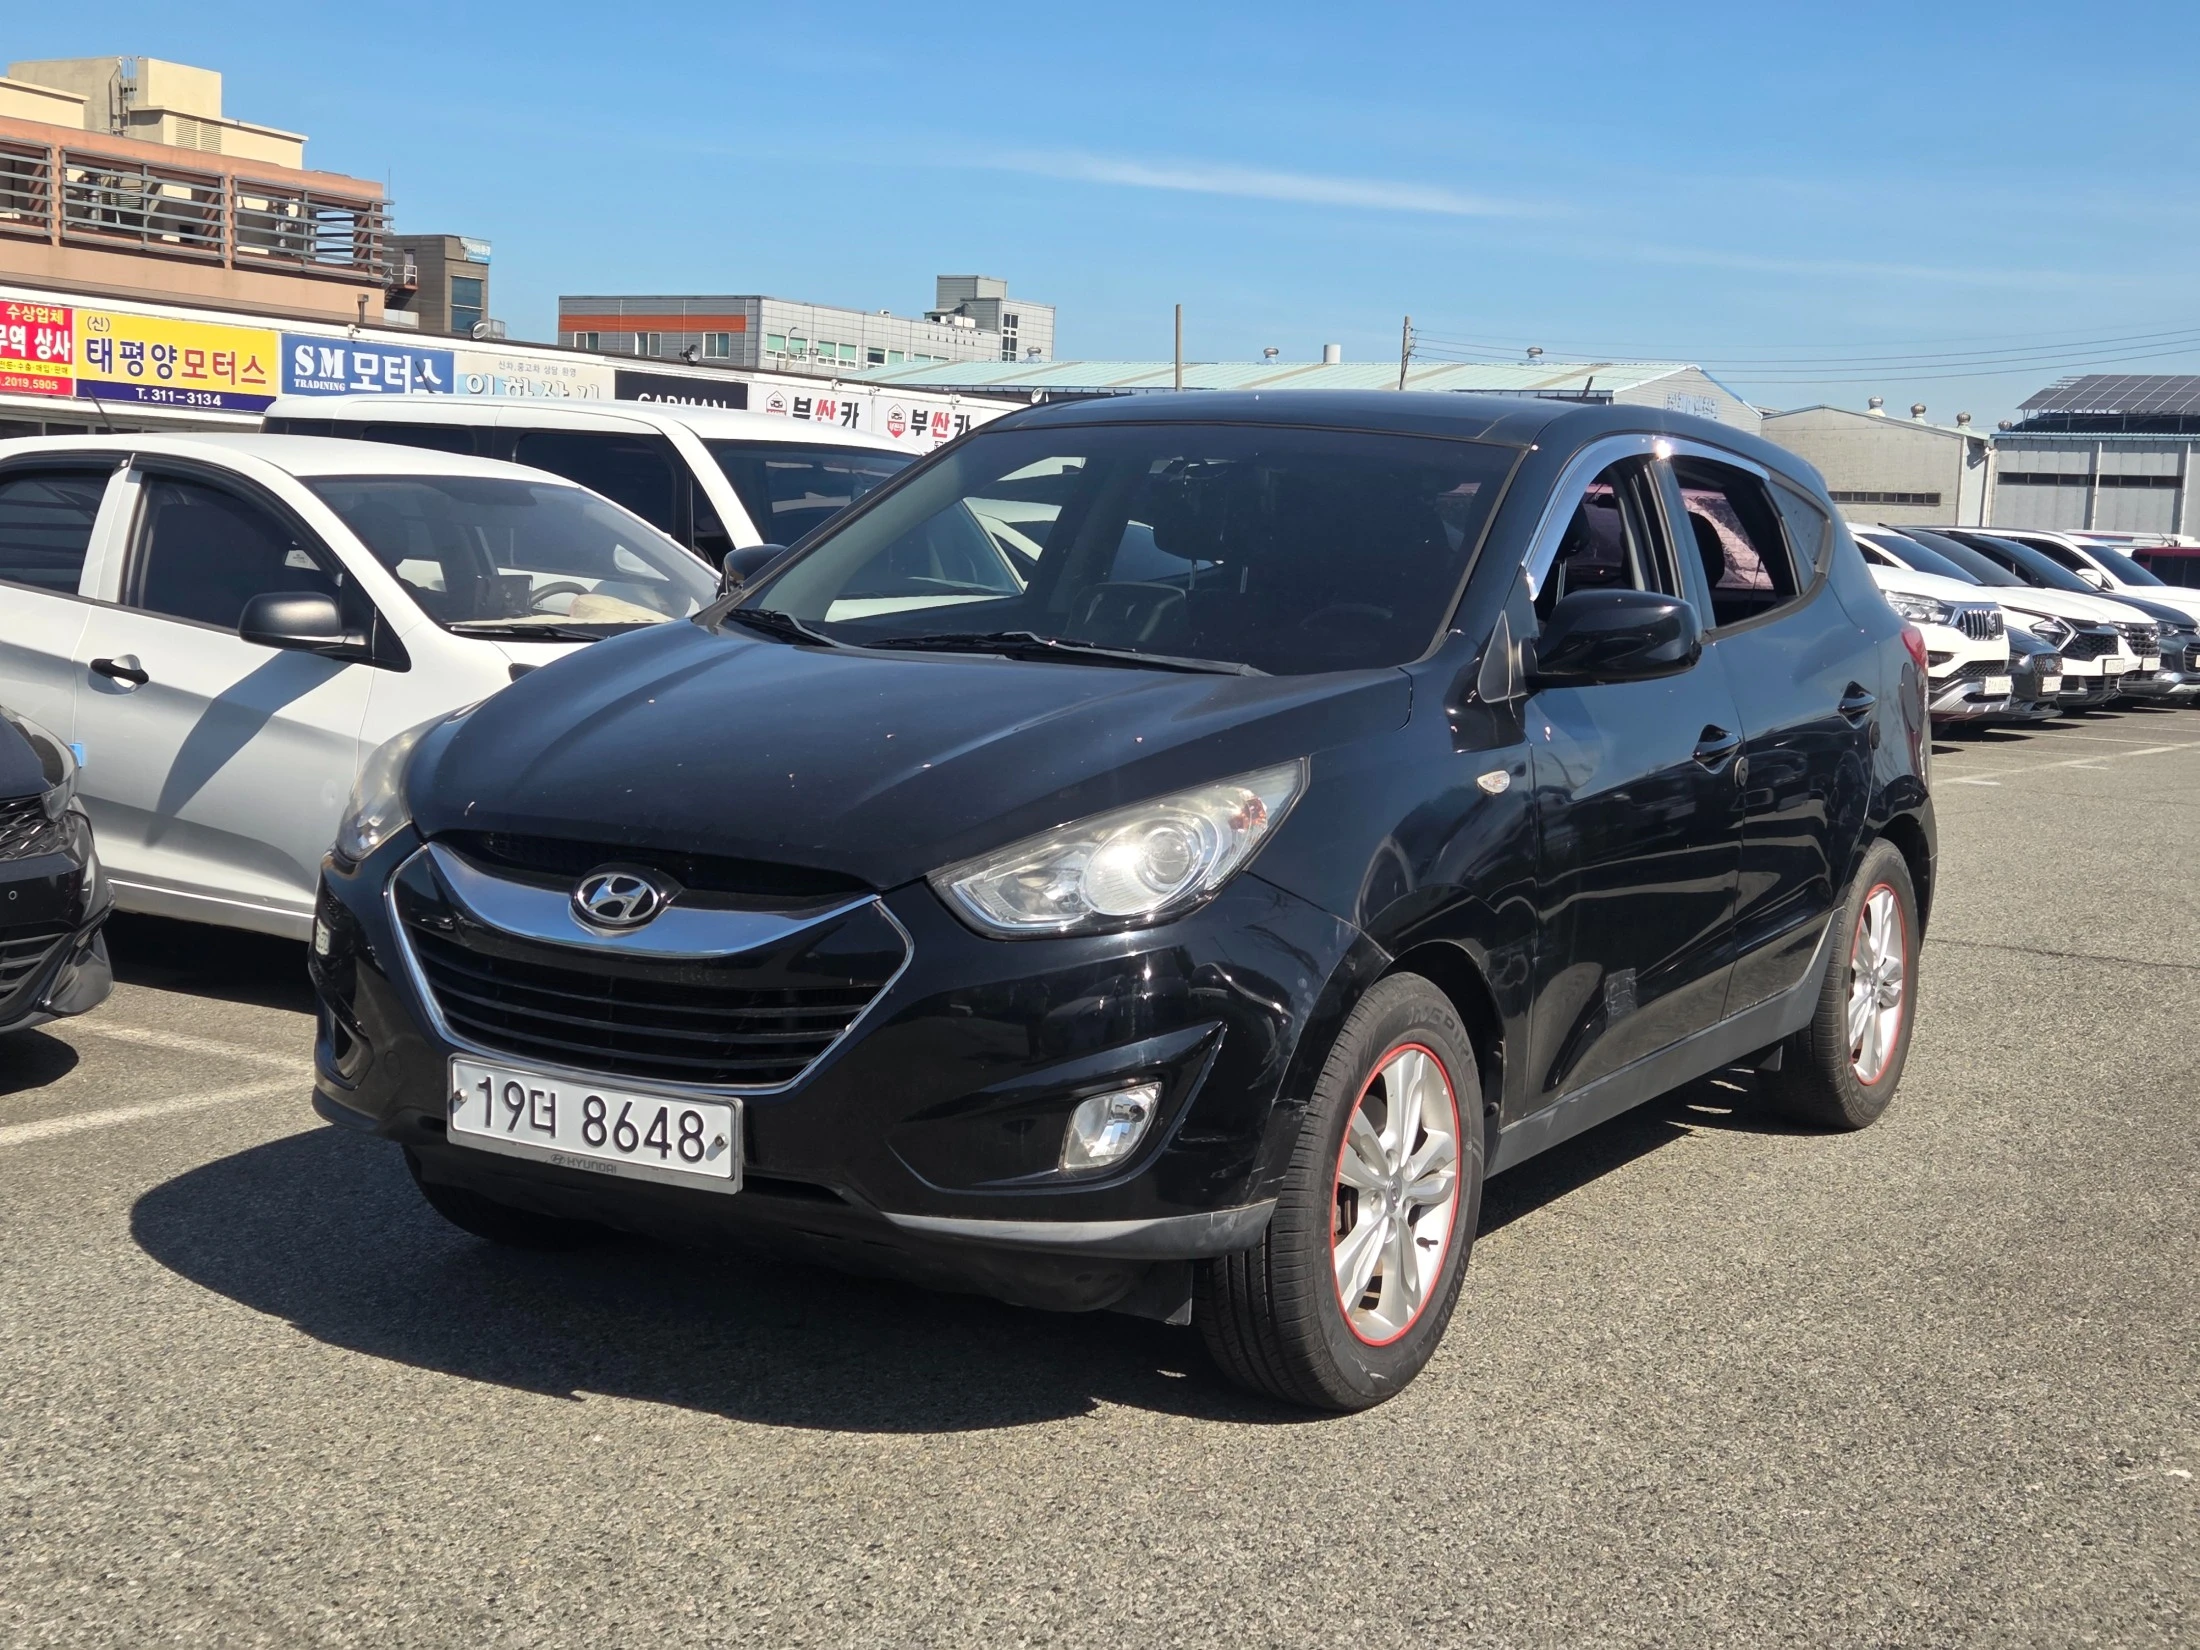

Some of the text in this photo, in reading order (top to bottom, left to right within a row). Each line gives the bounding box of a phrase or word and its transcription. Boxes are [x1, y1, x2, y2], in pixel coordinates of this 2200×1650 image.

[6, 304, 64, 326] 수상업체
[87, 316, 110, 332] (신)
[34, 327, 71, 362] 상사
[294, 344, 443, 394] SM 모터스
[151, 389, 222, 406] 311-3134
[477, 1076, 705, 1164] 19더 8648
[567, 1156, 617, 1174] HYUNDAI
